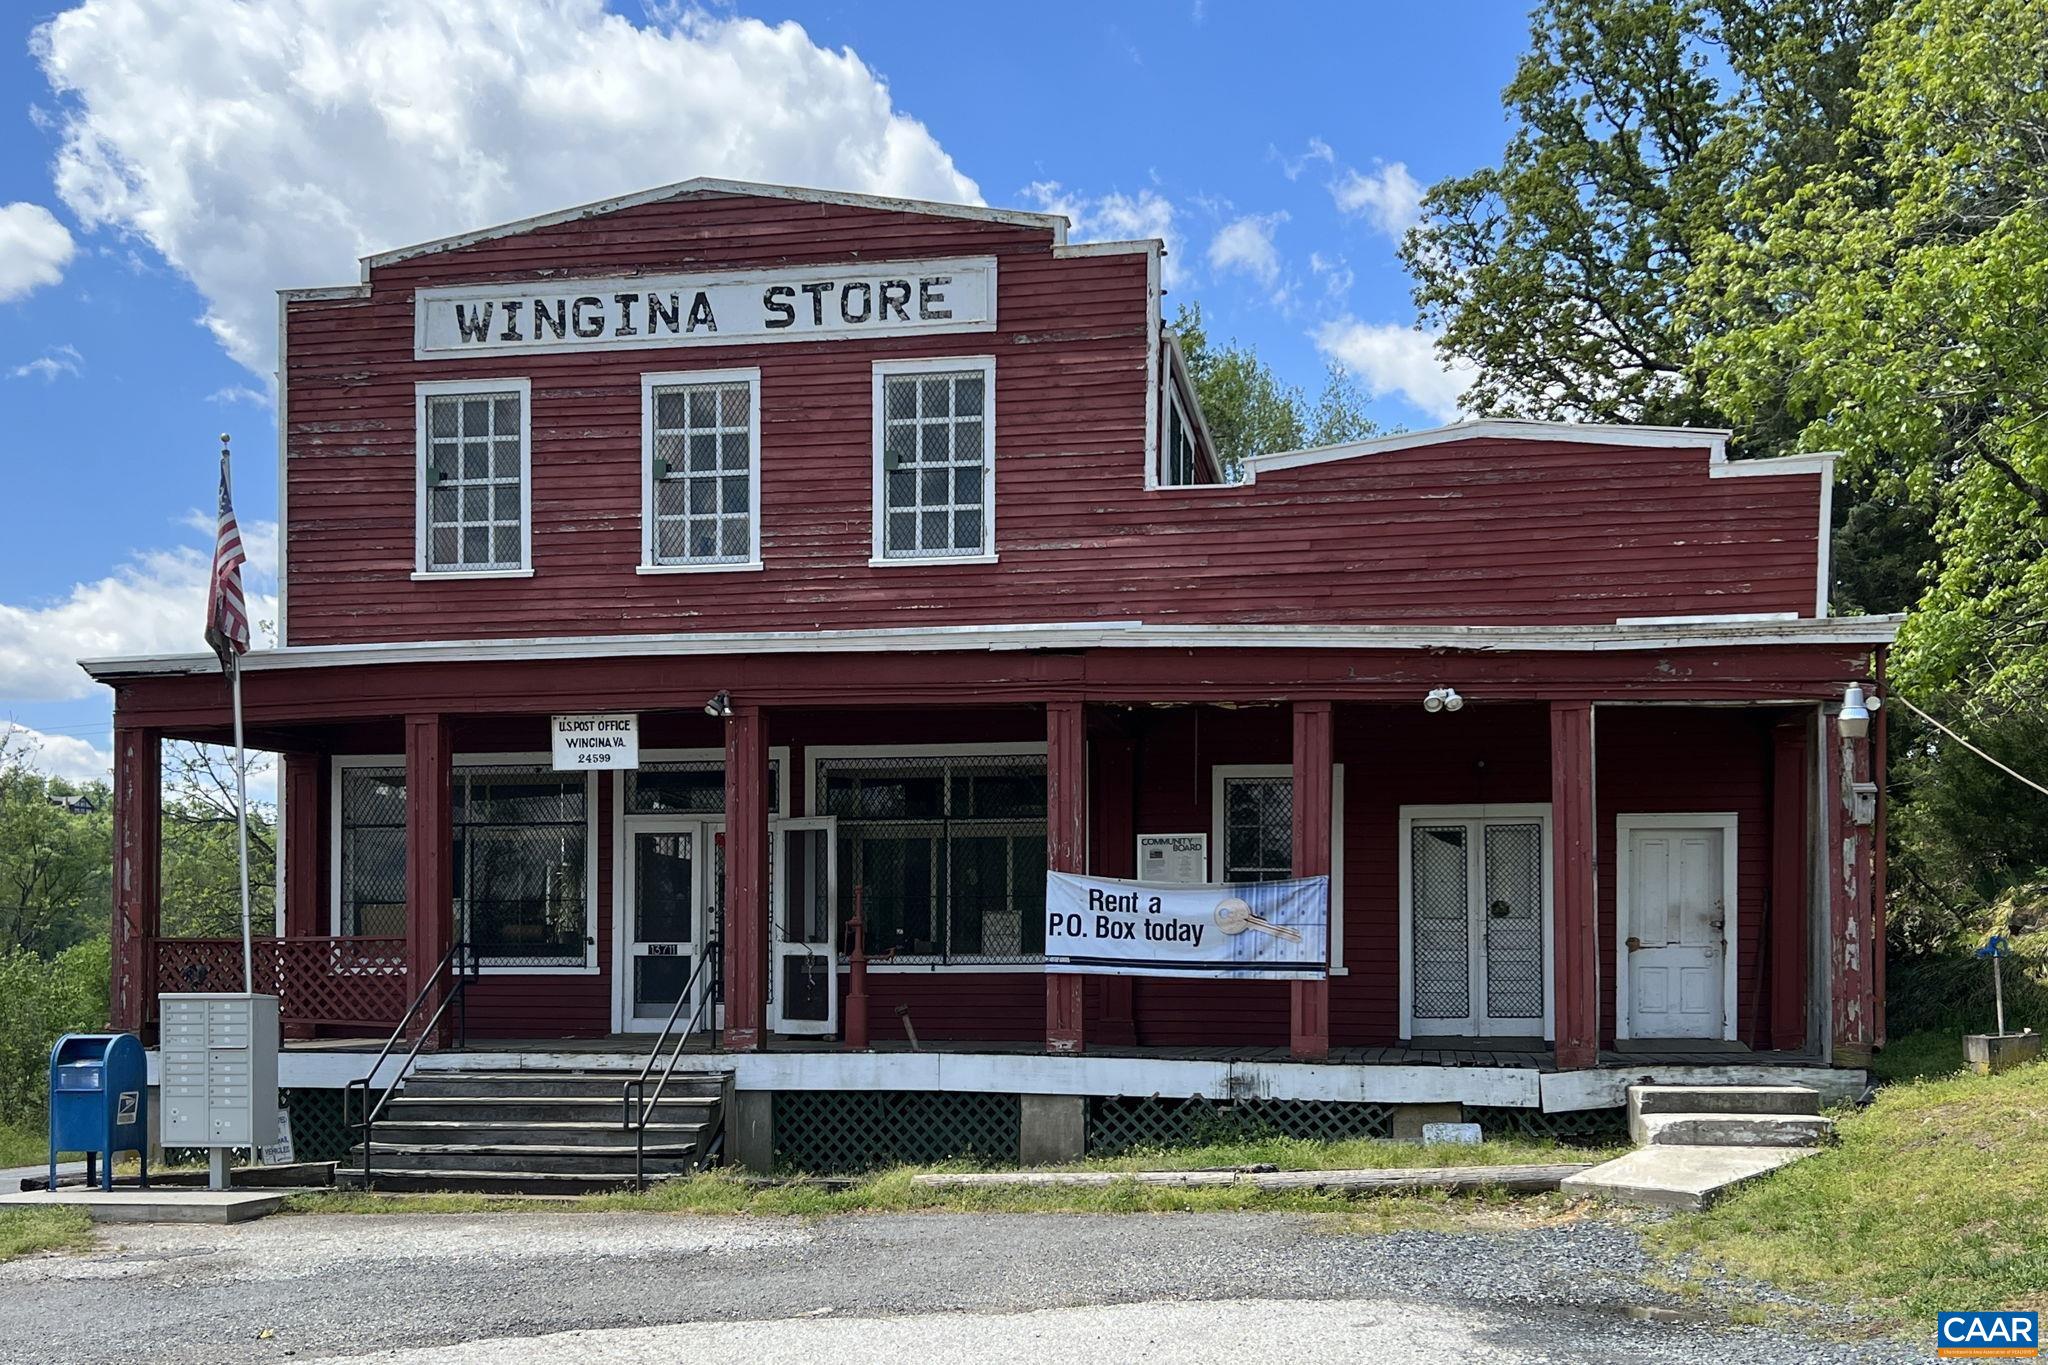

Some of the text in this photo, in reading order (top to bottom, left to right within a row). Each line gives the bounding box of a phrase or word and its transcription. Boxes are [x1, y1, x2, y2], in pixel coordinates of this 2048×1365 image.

[455, 276, 953, 344] WINGINA STORE
[598, 719, 631, 731] OFFICE
[578, 753, 611, 764] 24599
[1141, 837, 1193, 846] COMMUNITY
[1173, 843, 1202, 852] BOARD
[1088, 888, 1162, 914] Rent a
[1049, 912, 1205, 947] P.O. Box today
